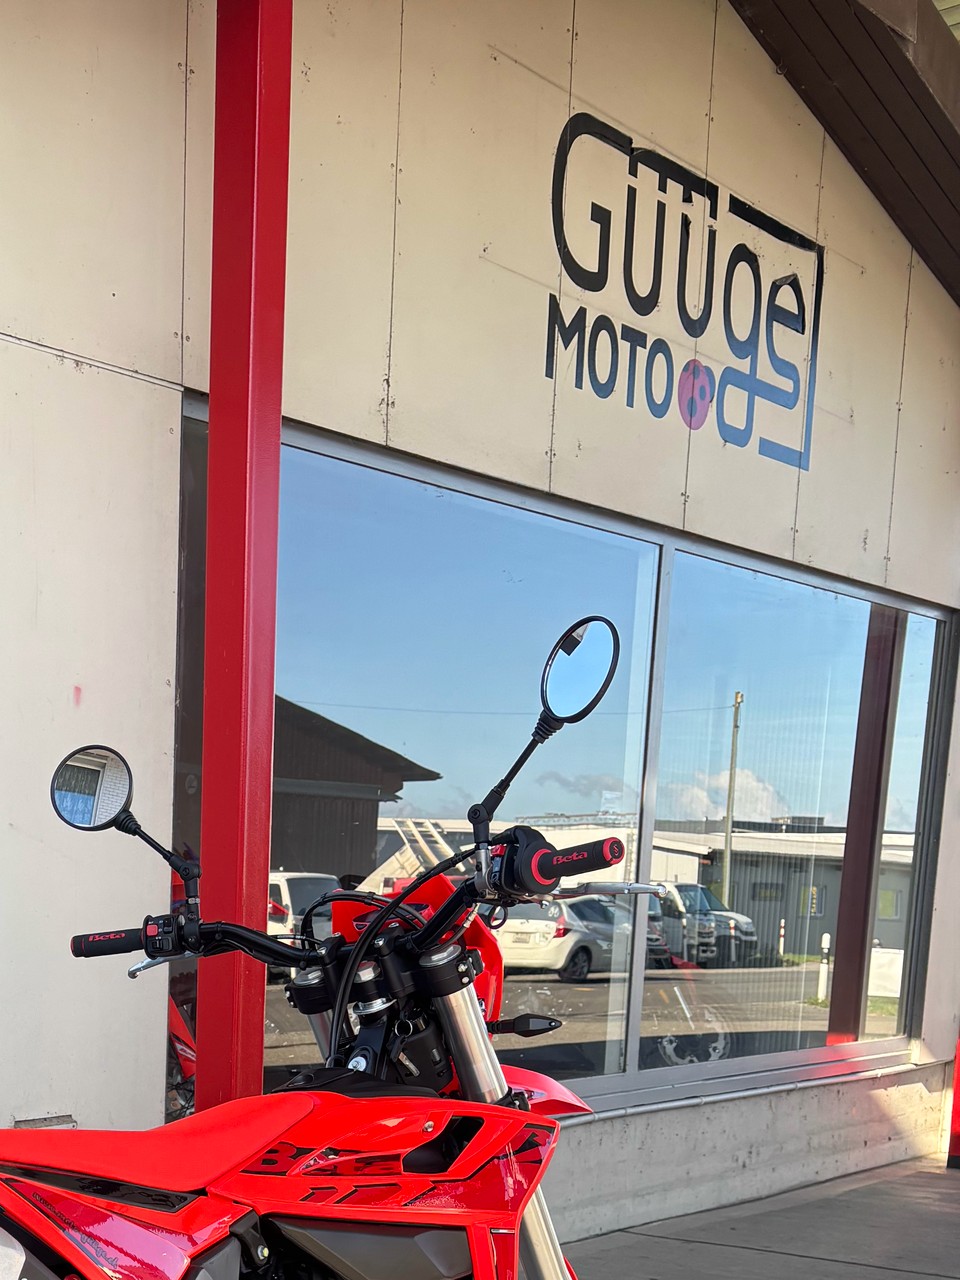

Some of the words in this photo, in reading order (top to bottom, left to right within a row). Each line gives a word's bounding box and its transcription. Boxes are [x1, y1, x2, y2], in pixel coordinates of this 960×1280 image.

[544, 293, 674, 418] MOTO
[552, 850, 588, 865] Beta
[88, 932, 126, 942] Beta
